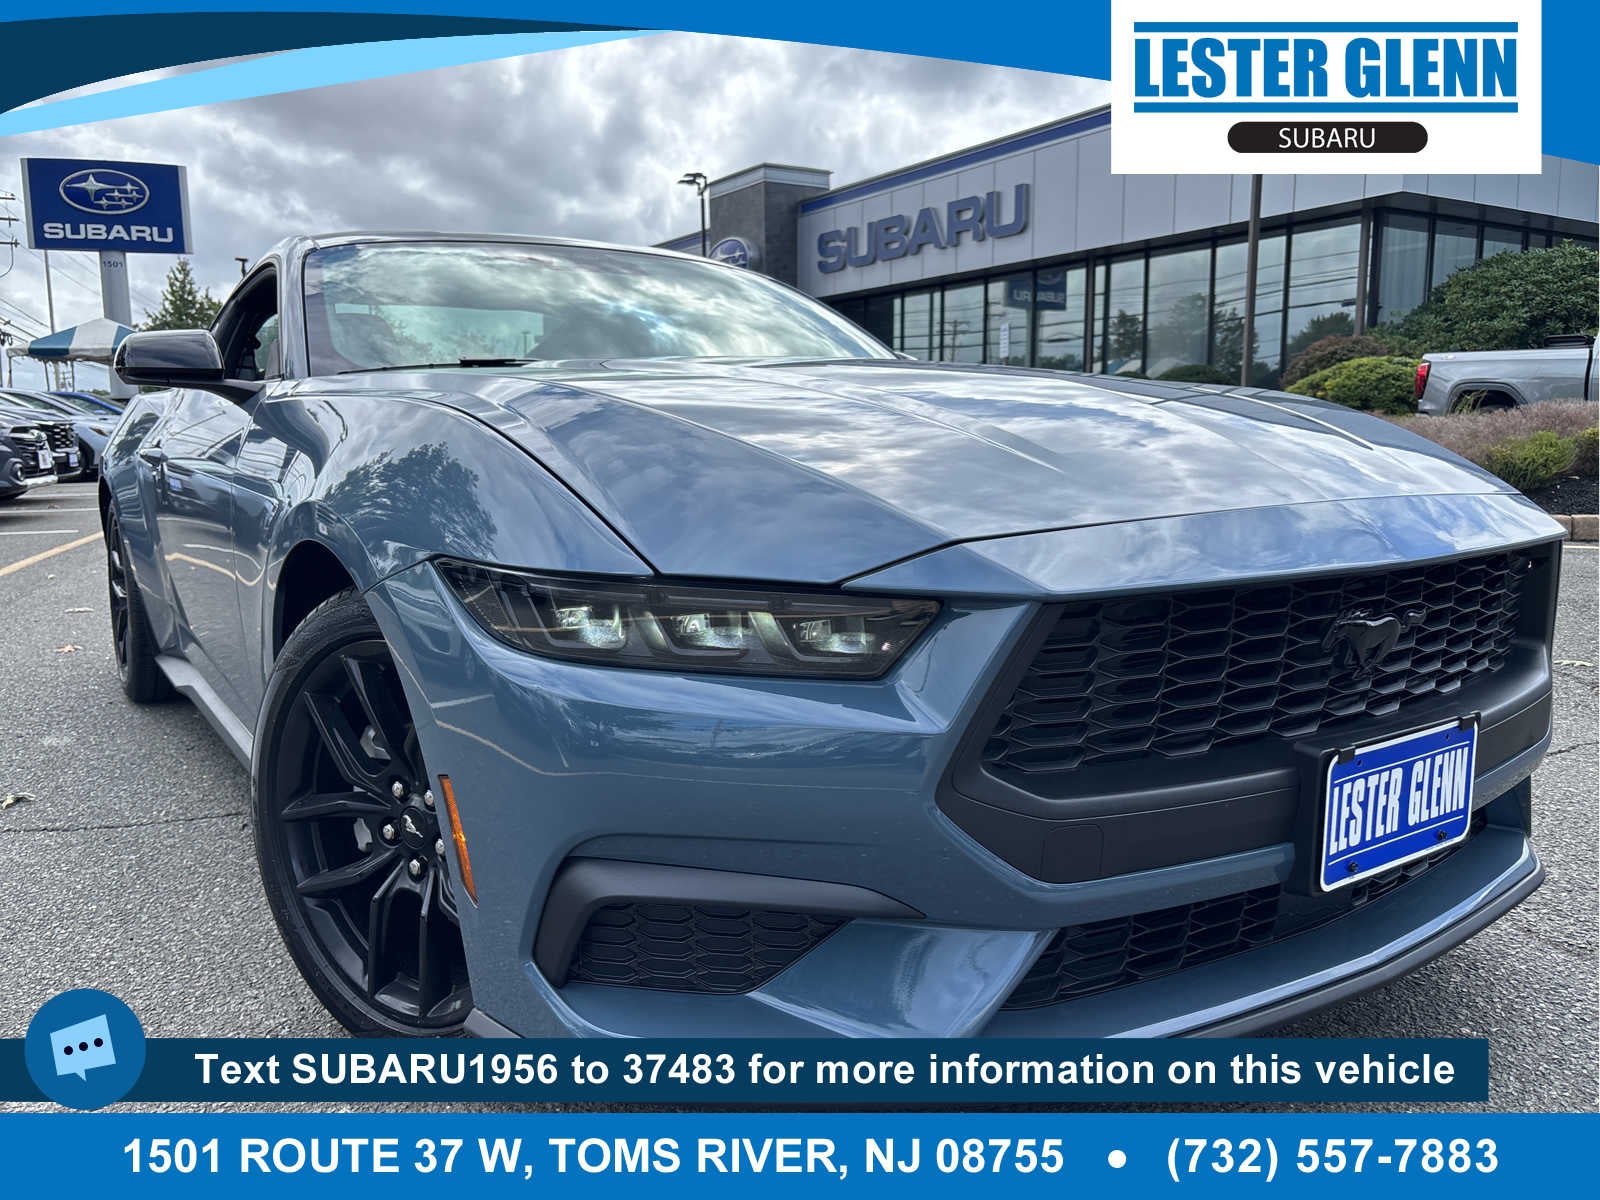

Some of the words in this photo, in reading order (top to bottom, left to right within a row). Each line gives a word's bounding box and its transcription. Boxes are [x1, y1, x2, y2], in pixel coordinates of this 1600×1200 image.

[43, 222, 174, 243] SUBARU
[817, 183, 1030, 275] SUBARU
[103, 260, 123, 268] 1501
[1329, 767, 1403, 856] LESTER
[1407, 746, 1469, 827] GLENN
